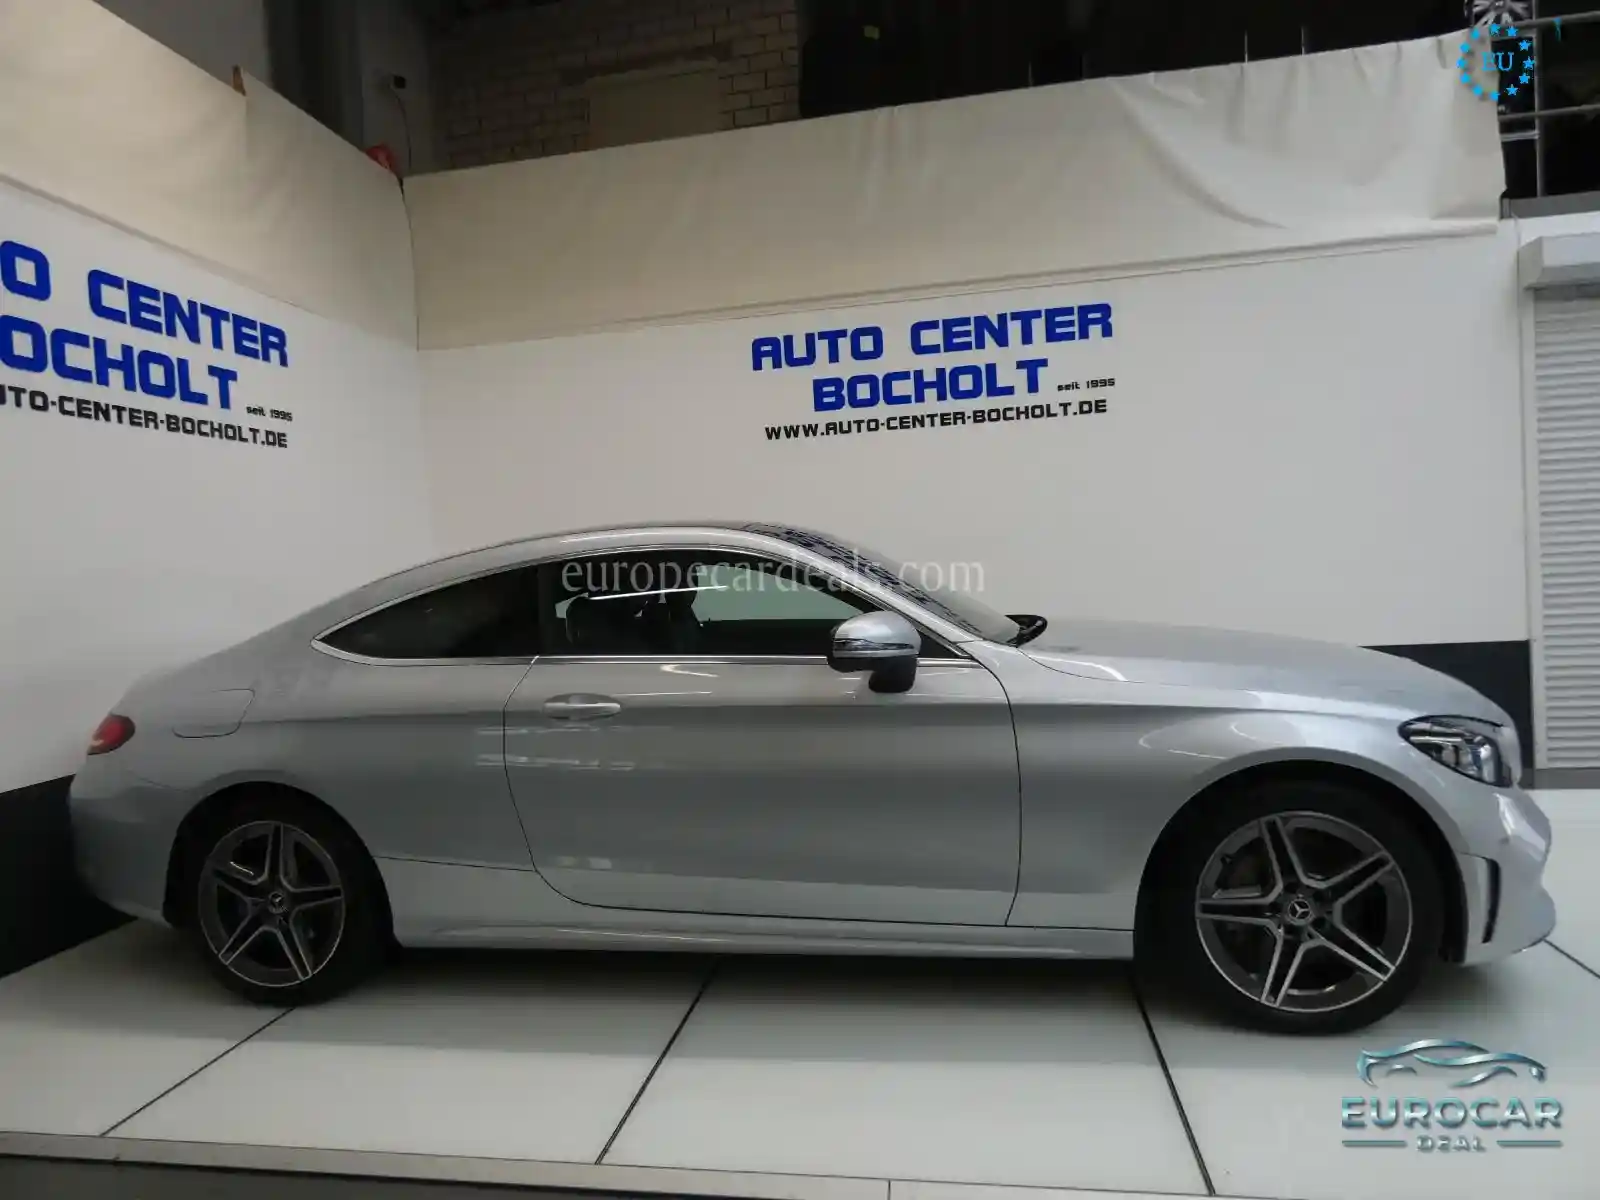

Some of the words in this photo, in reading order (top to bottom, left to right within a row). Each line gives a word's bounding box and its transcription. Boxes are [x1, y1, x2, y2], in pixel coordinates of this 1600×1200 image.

[87, 269, 289, 367] CENTER
[751, 326, 884, 371] AUTO
[910, 303, 1113, 355] CENTER
[0, 314, 238, 410] OCHOLT
[812, 358, 1049, 412] BOCHOLT
[1057, 381, 1081, 392] seit
[1085, 377, 1115, 389] 1995
[246, 405, 266, 417] seit
[269, 408, 293, 421] 1995
[765, 398, 1108, 440] WWW.AUTO-CENTER-BOCHOLT.DE
